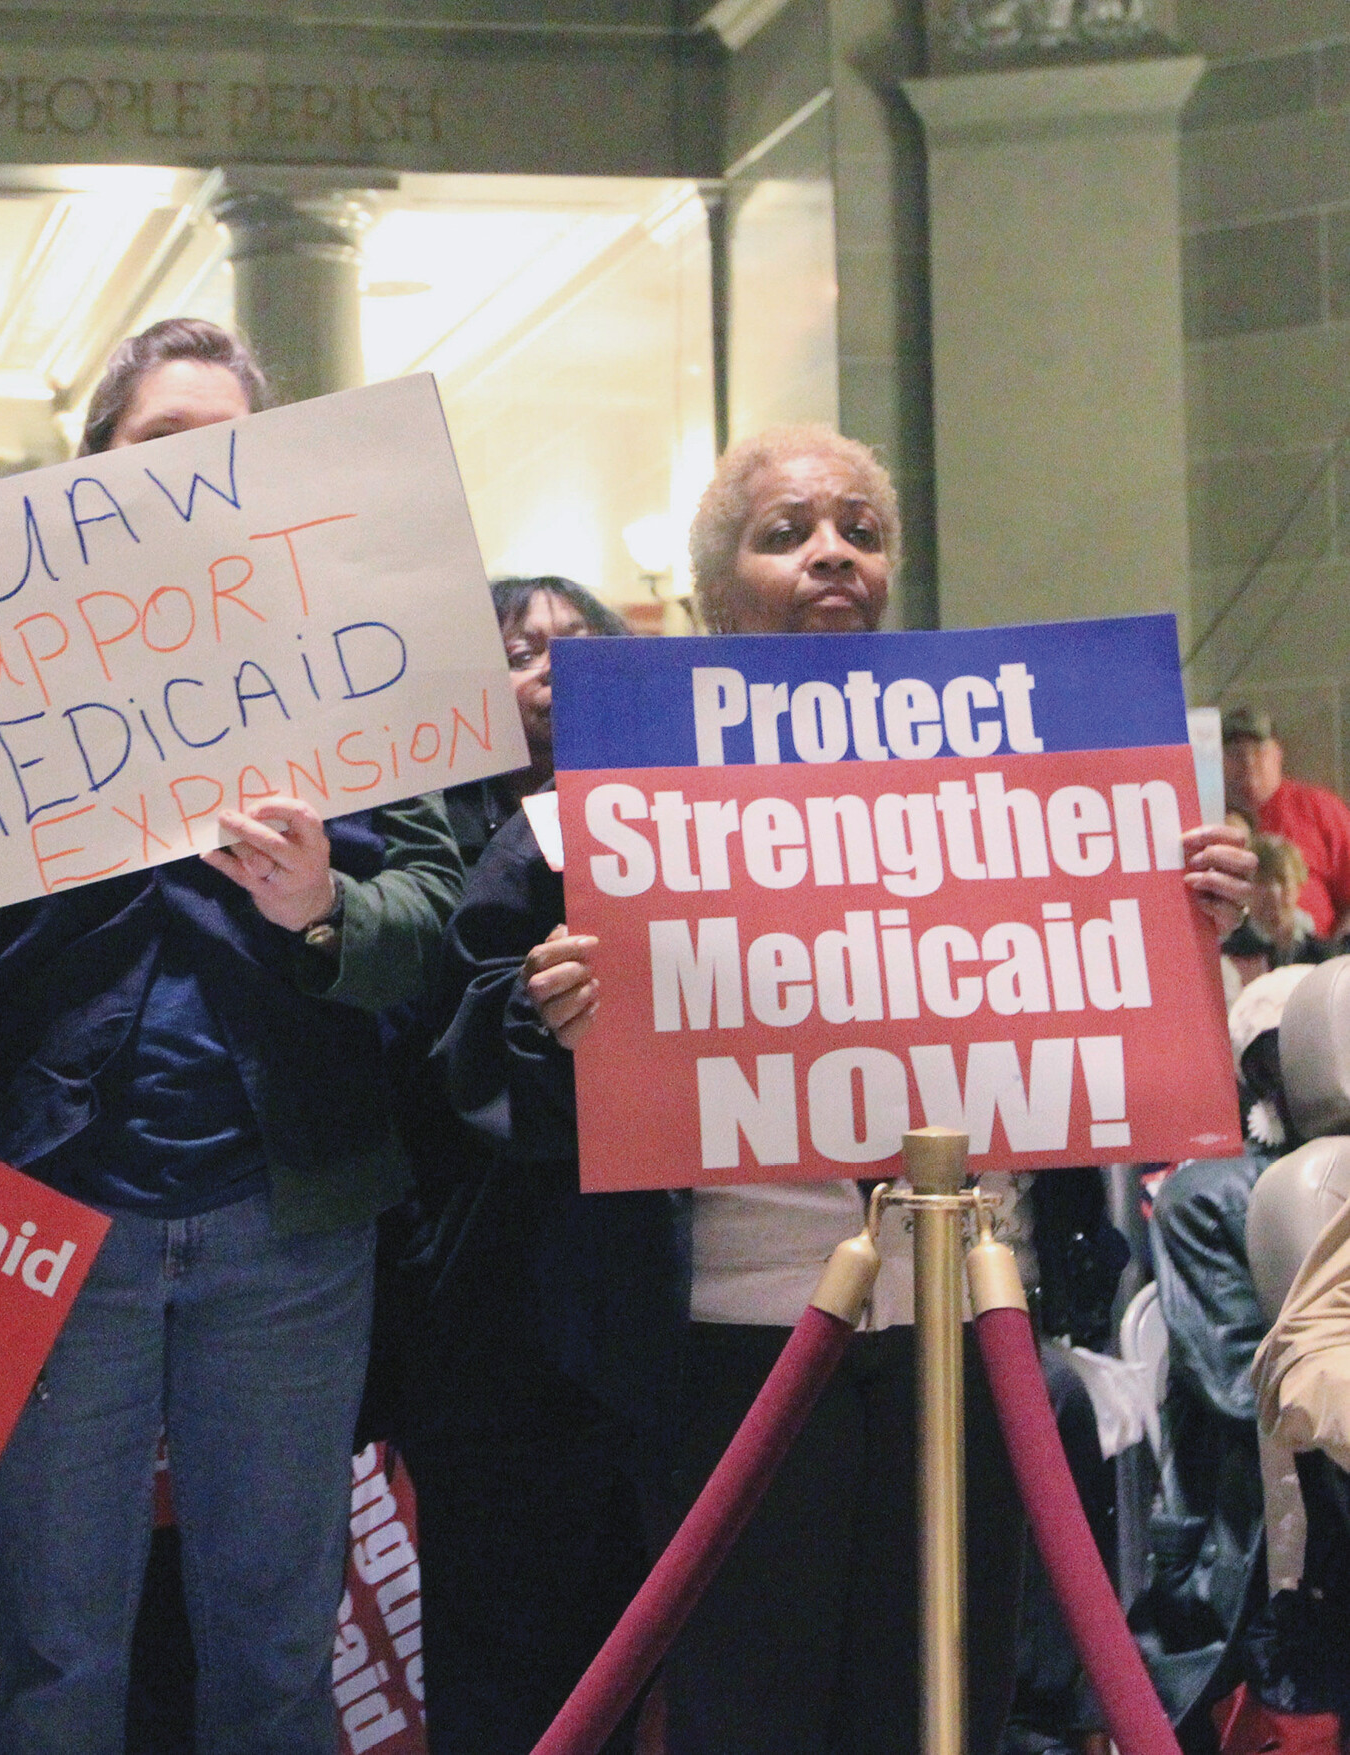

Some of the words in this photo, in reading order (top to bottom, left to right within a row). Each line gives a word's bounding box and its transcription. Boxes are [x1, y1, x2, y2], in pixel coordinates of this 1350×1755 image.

[227, 82, 444, 144] PERISH
[691, 662, 1044, 767] Protect
[584, 771, 1185, 898] Strengthen
[648, 898, 1152, 1034] Medicaid
[696, 1034, 1132, 1170] NOW!
